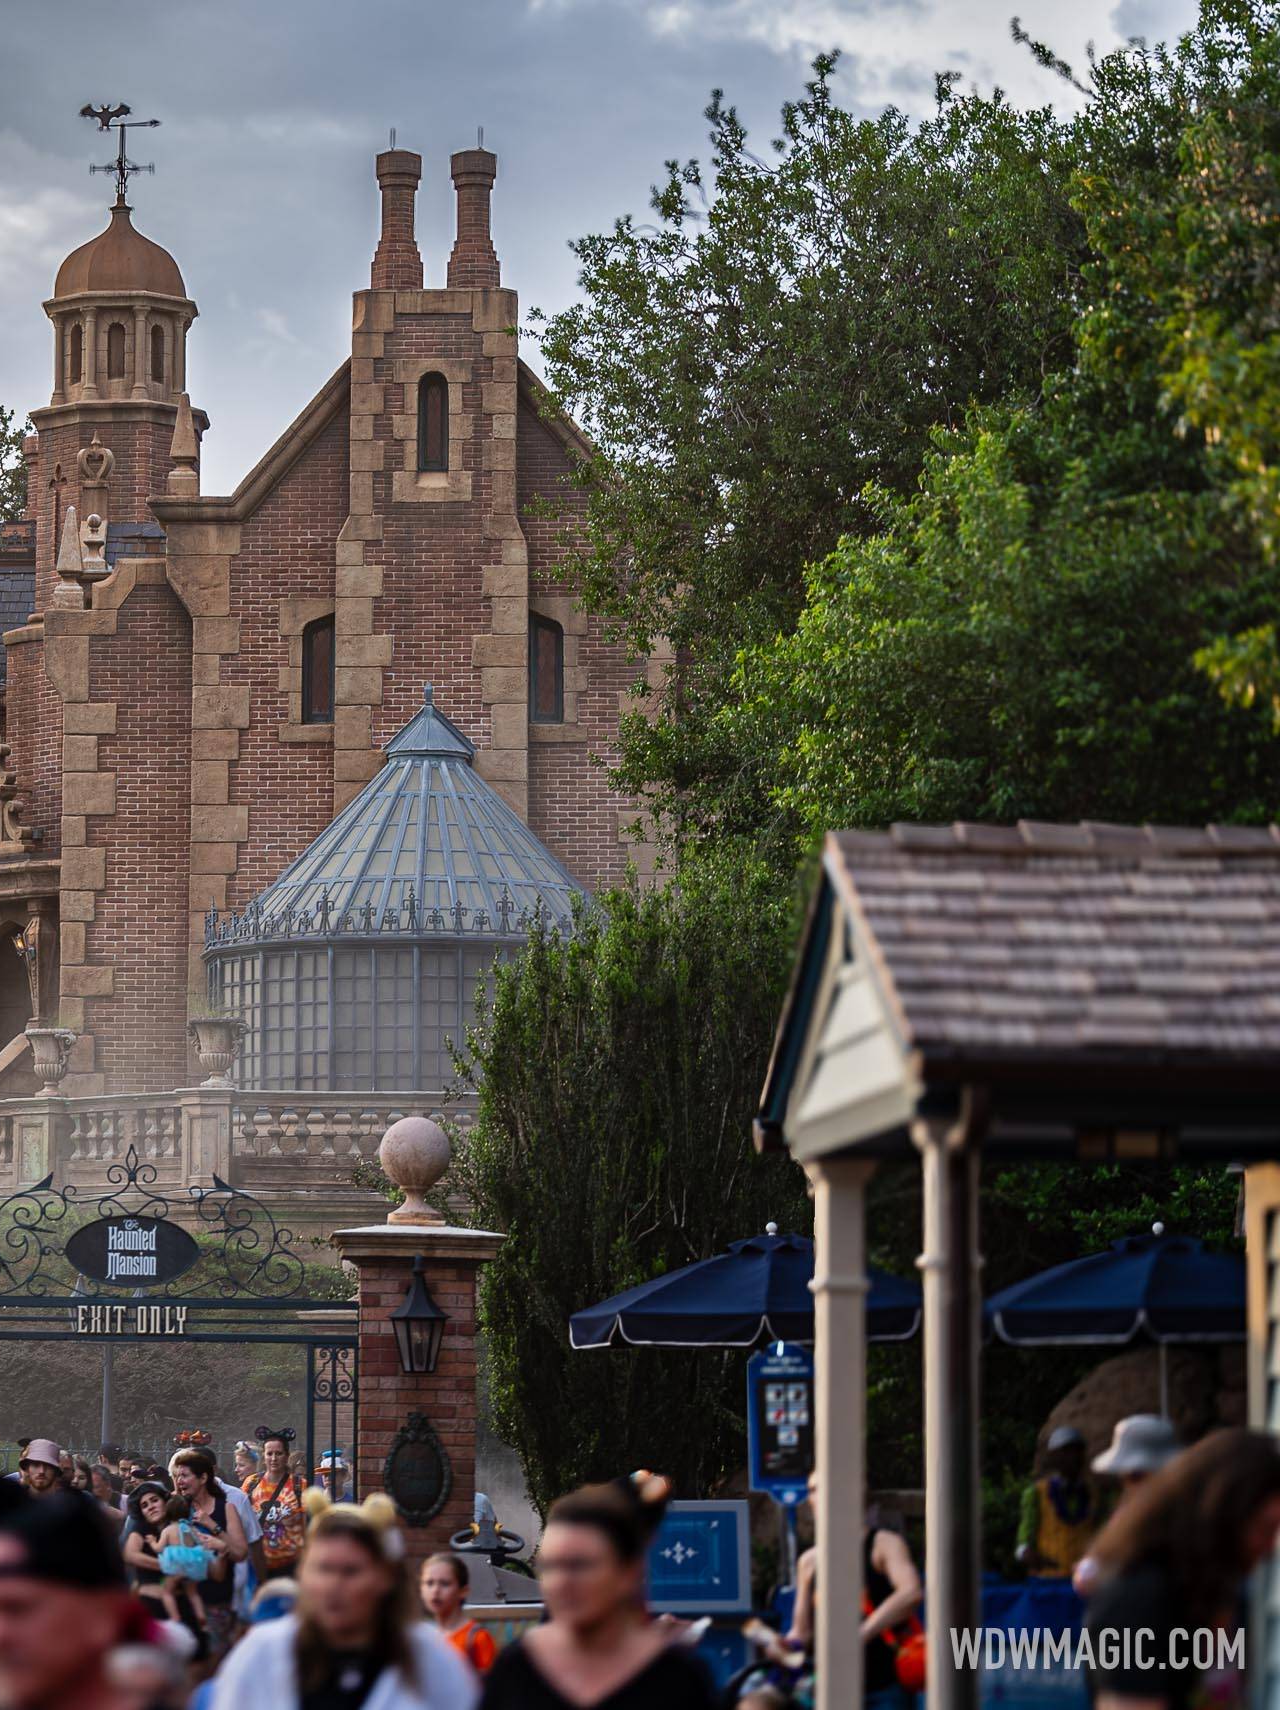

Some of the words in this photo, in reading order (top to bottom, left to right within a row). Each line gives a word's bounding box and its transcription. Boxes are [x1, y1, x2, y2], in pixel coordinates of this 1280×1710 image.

[107, 1224, 158, 1251] Haunted
[105, 1251, 157, 1280] Mansion
[77, 1305, 127, 1334] EXIT
[137, 1306, 188, 1335] ONLY
